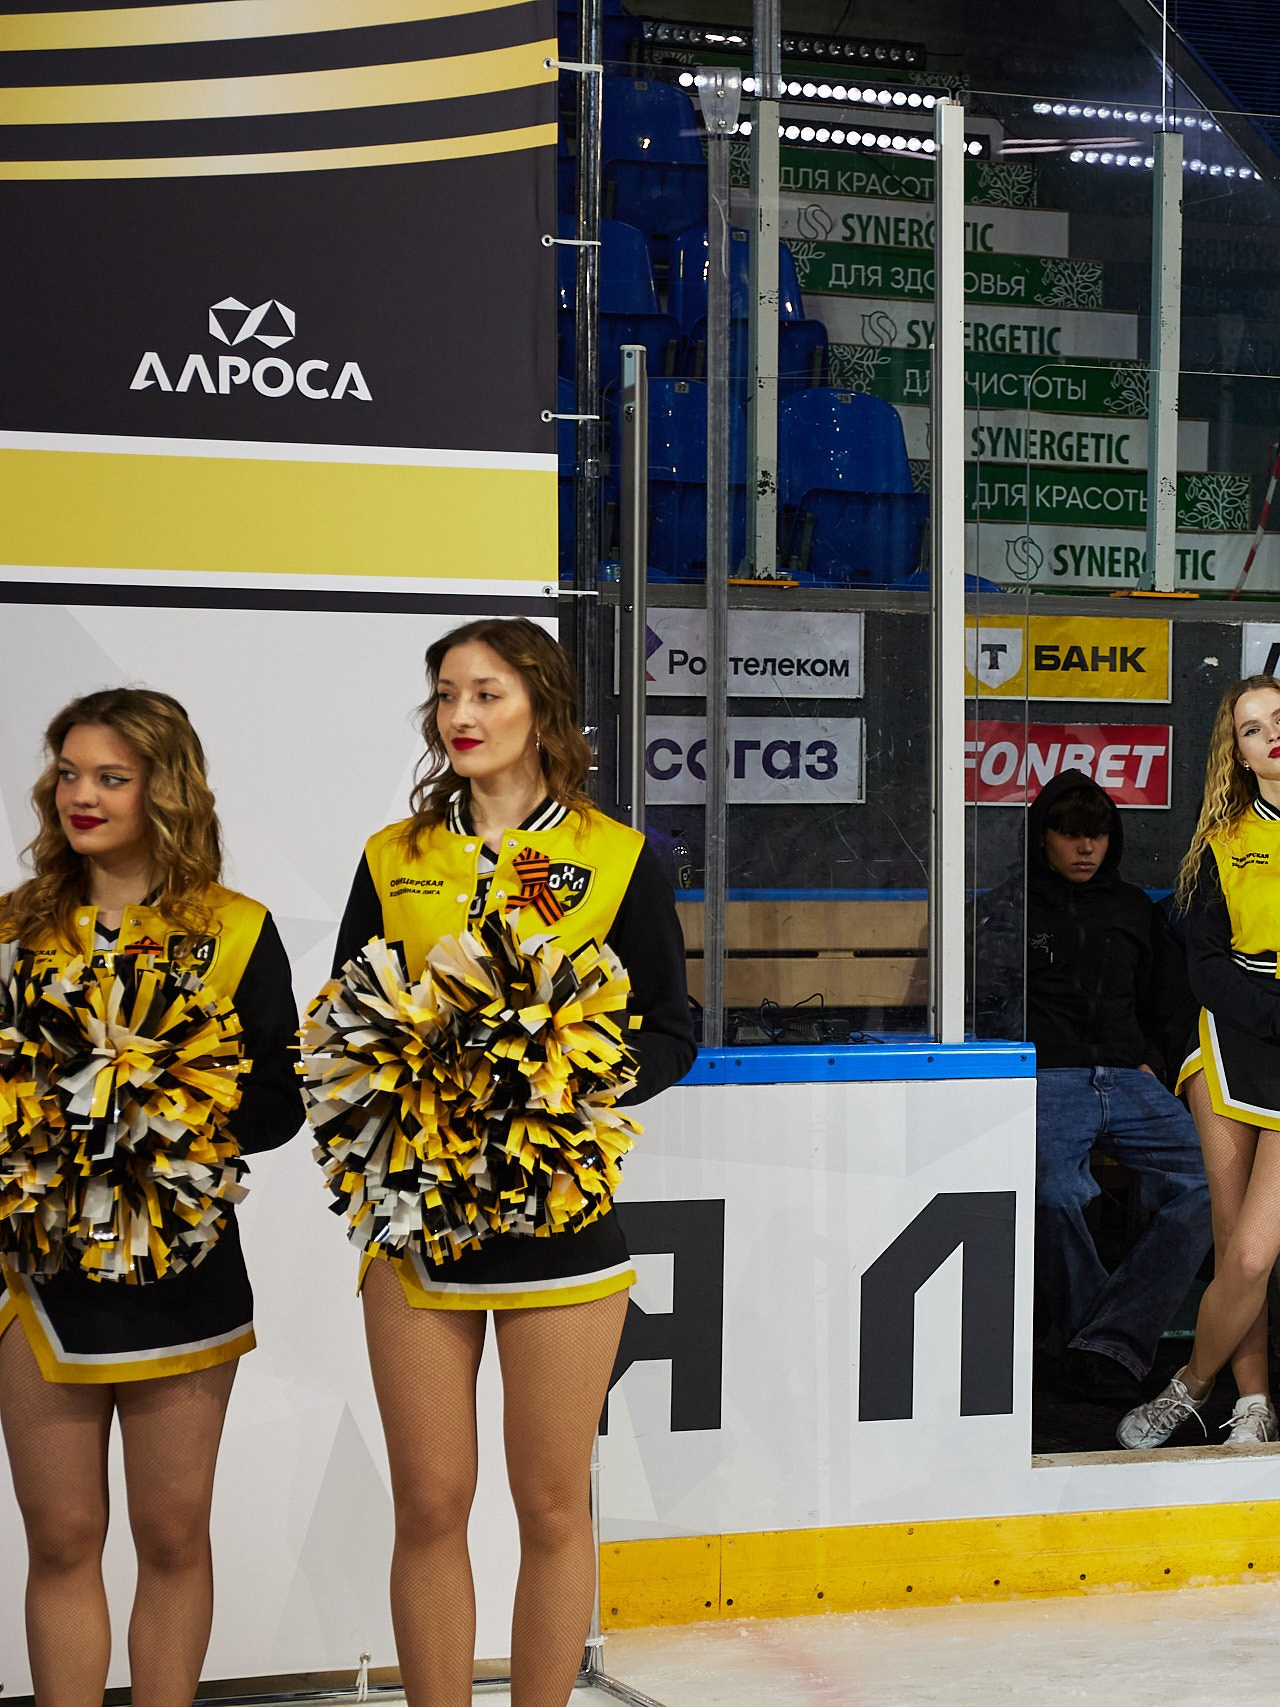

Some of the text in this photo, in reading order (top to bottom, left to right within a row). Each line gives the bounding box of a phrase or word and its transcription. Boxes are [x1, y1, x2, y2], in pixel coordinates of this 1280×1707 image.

[837, 171, 934, 198] КРАСОТ
[829, 263, 1025, 297] ДЛЯ ЗДООВЬЯ
[129, 351, 374, 401] АЛРОСА
[965, 371, 1087, 401] ЧИСТОТЫ
[971, 425, 1130, 465] SYNERGETIC
[972, 482, 1028, 509] ДЛЯ
[668, 649, 849, 677] Ротелеком
[1034, 645, 1147, 673] БАНК
